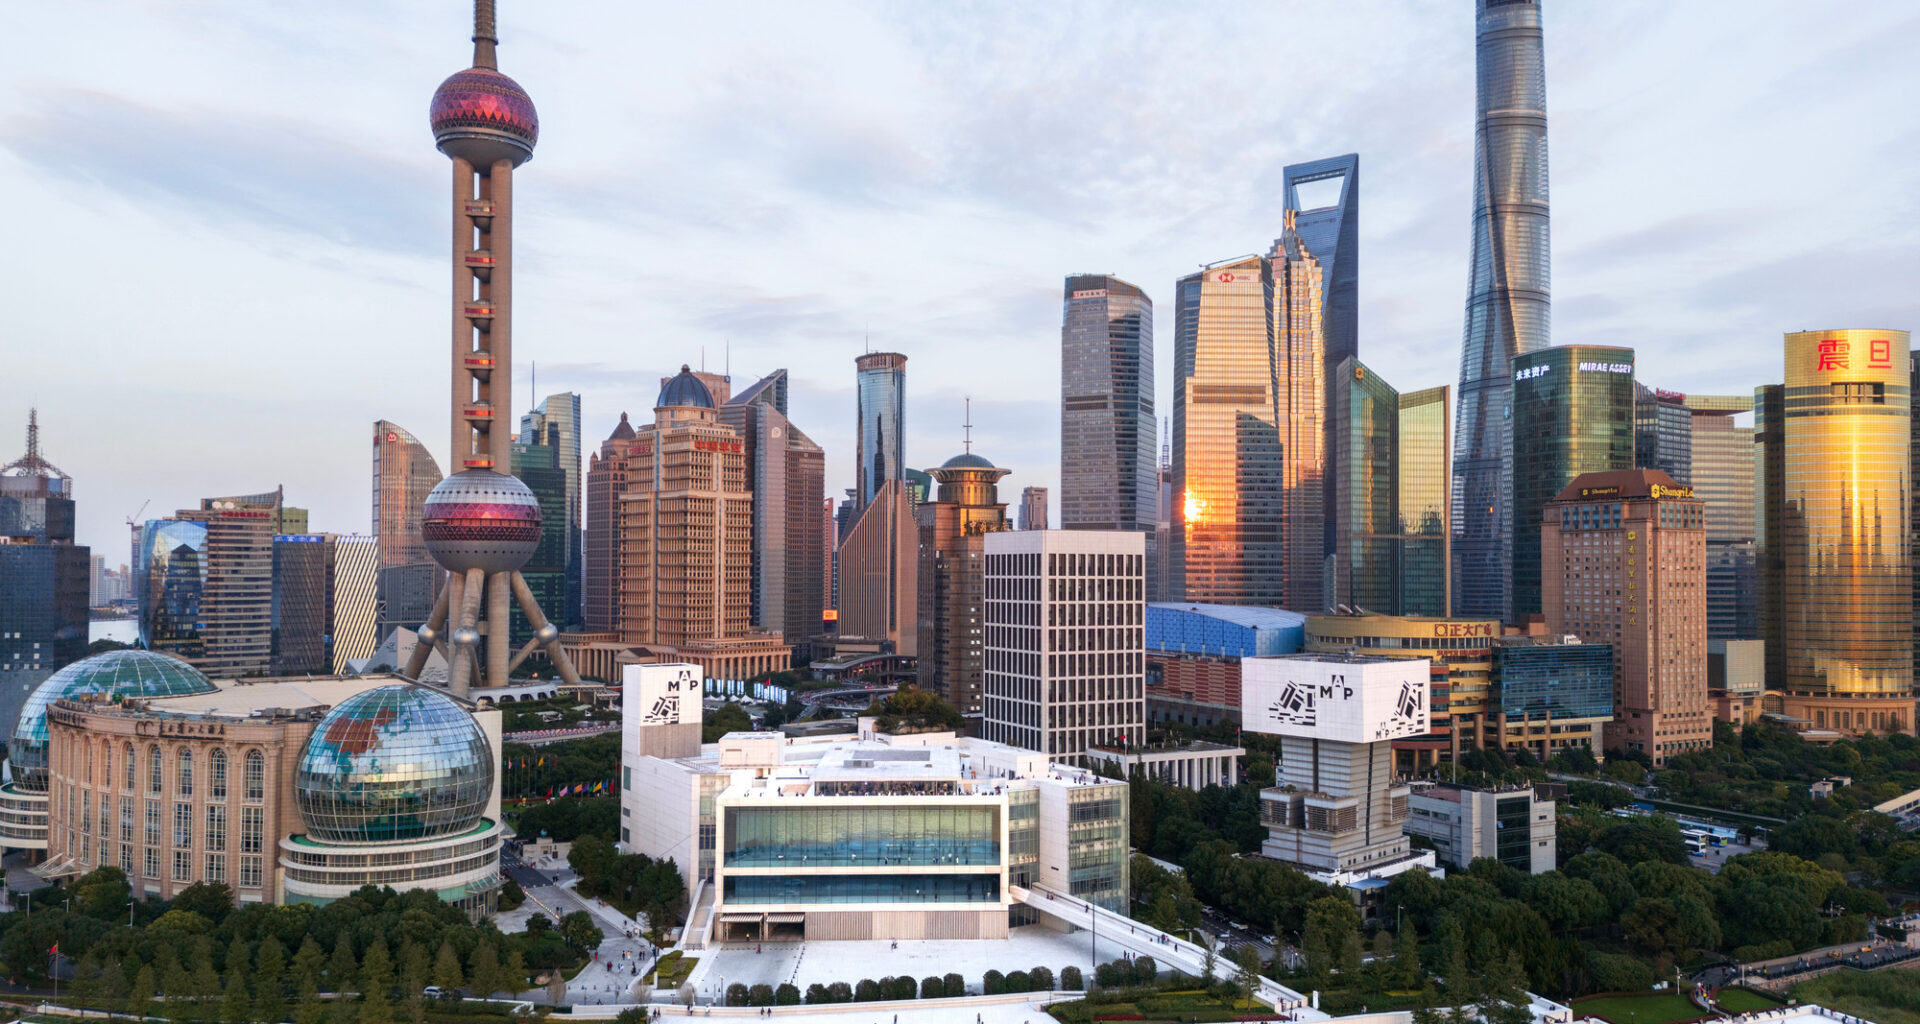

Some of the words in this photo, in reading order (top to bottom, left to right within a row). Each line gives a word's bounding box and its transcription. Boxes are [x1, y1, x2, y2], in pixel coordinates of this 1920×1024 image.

[1817, 339, 1893, 372] 震旦
[1515, 364, 1550, 381] 未来资产
[1579, 362, 1608, 372] MIRAE
[1608, 363, 1631, 373] ASSET
[1450, 623, 1492, 637] 正大广场
[668, 670, 699, 692] MAP
[1320, 674, 1353, 701] MAP
